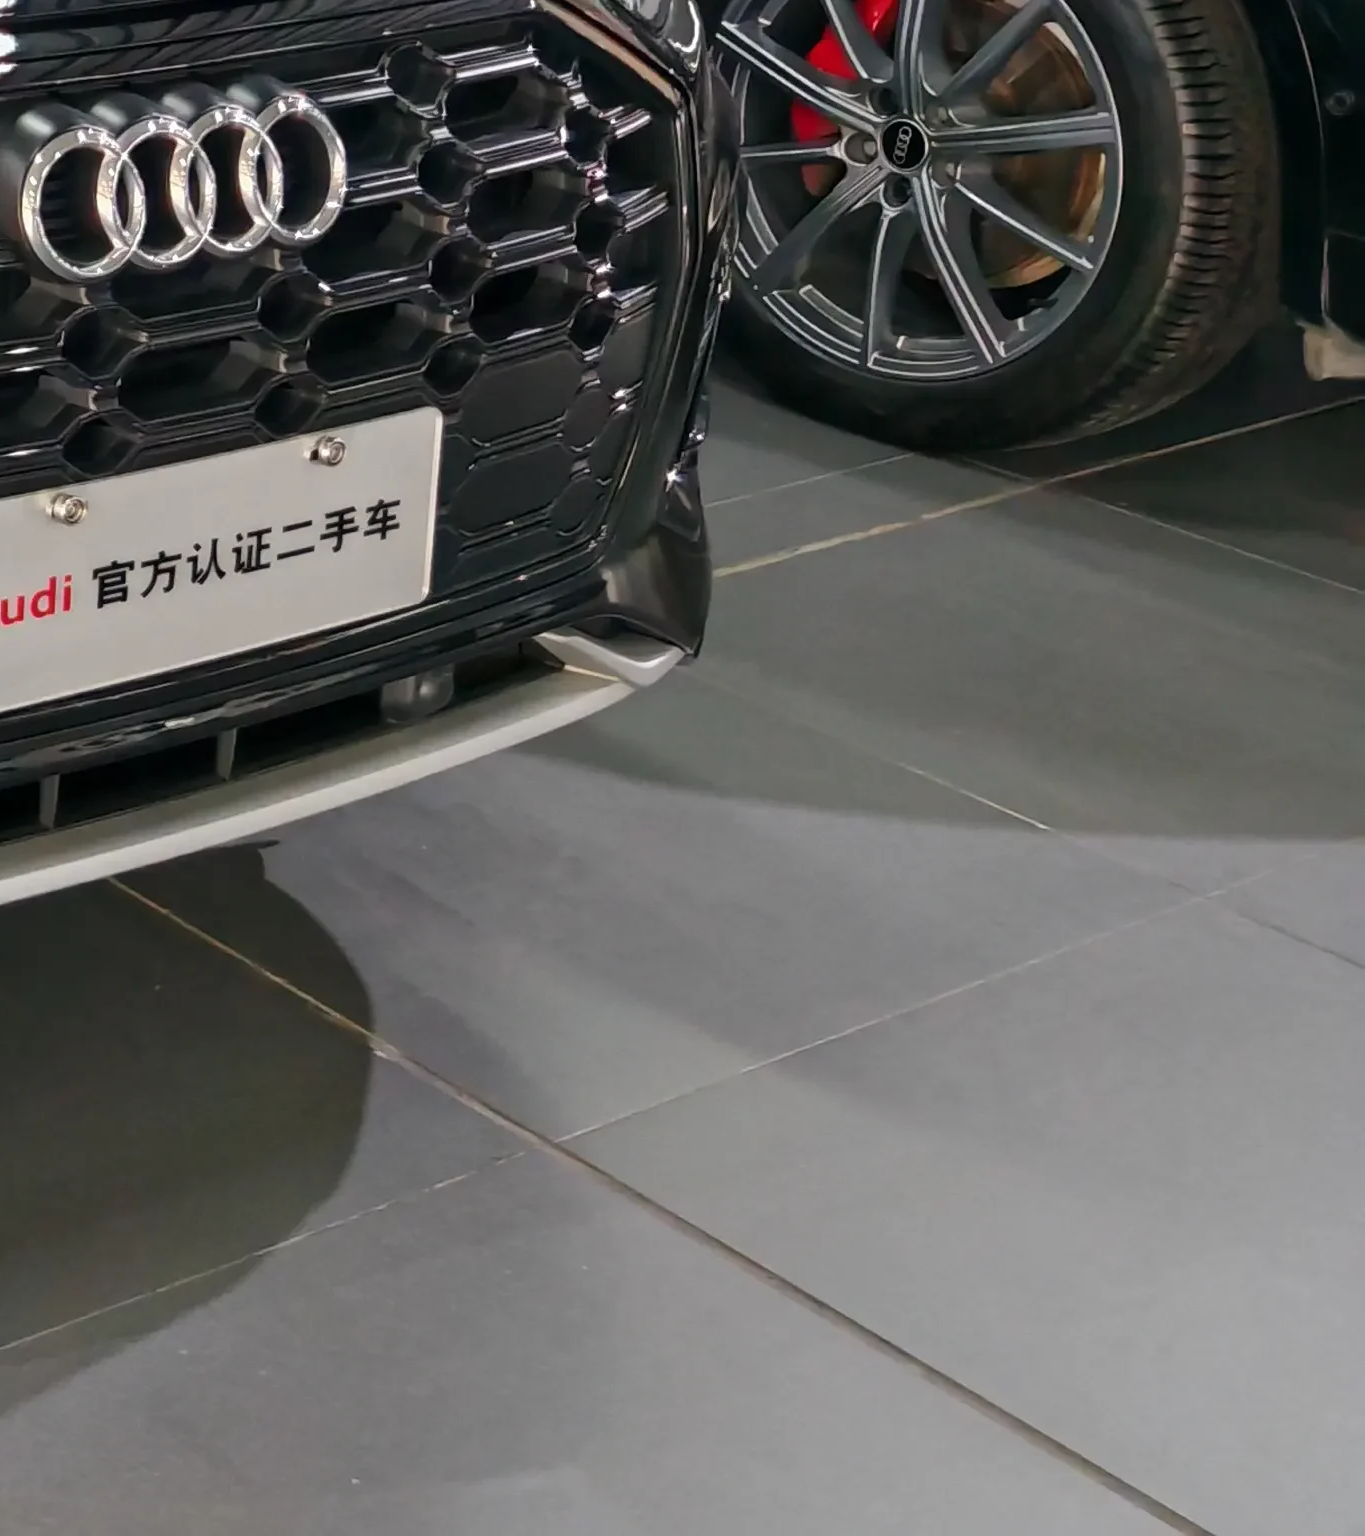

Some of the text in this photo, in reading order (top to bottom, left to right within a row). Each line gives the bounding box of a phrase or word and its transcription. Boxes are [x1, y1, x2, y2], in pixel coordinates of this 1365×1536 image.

[91, 498, 402, 610] 官方认证二手车
